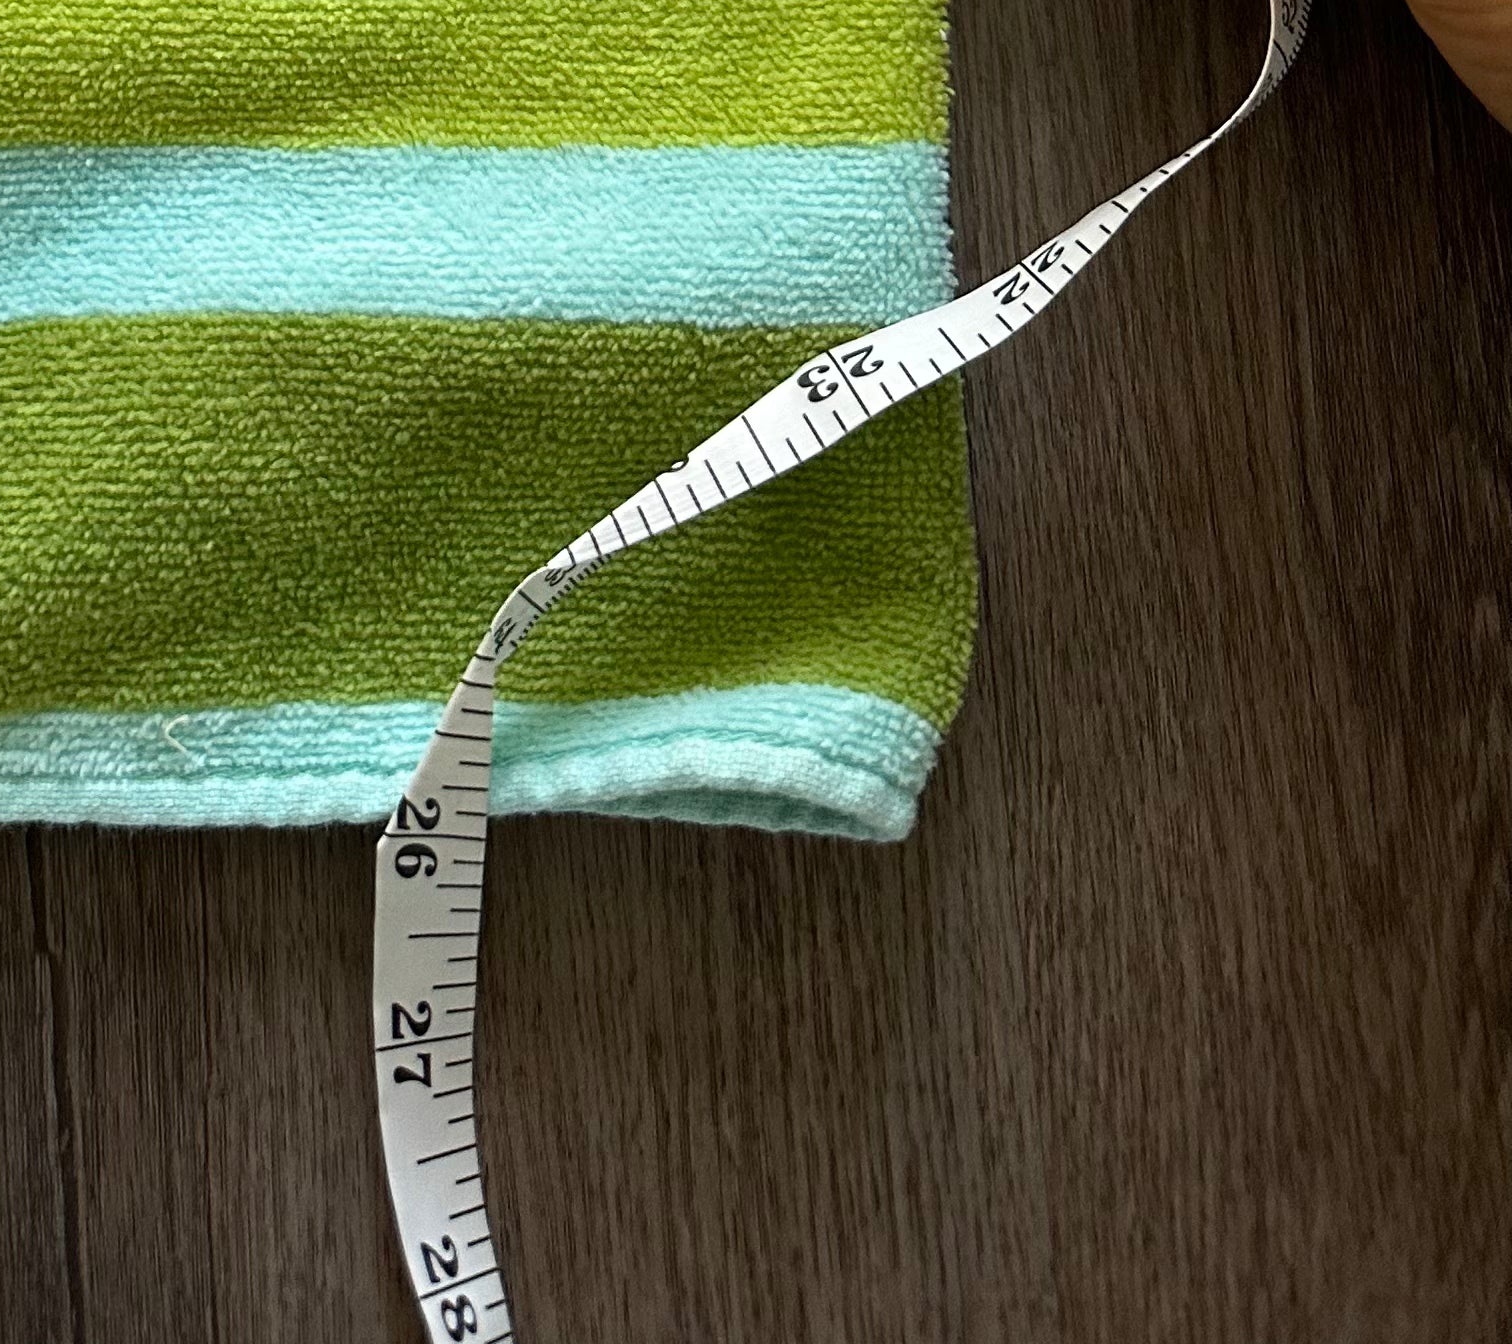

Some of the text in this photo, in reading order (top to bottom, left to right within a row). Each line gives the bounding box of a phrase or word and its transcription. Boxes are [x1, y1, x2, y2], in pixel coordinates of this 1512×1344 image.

[992, 240, 1065, 306] 22
[796, 344, 885, 403] 23
[394, 793, 441, 879] 26
[391, 1000, 433, 1088] 27
[420, 1234, 477, 1343] 28
